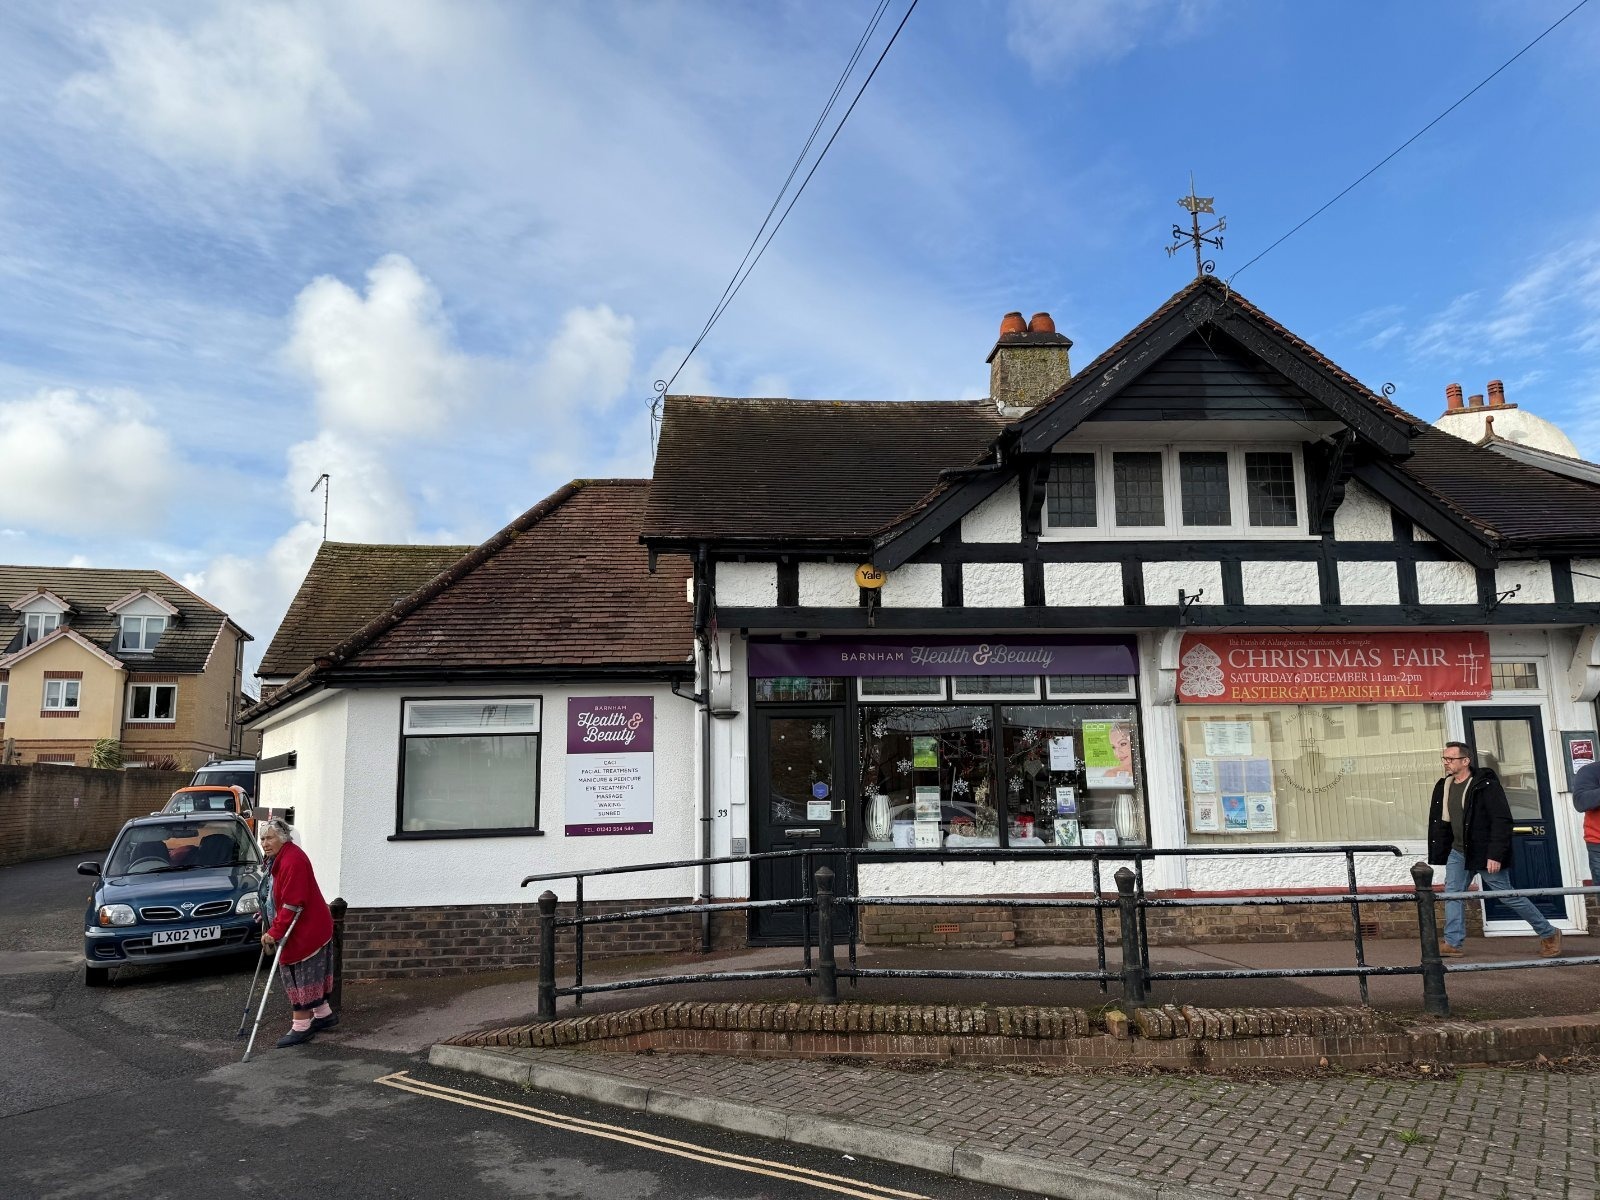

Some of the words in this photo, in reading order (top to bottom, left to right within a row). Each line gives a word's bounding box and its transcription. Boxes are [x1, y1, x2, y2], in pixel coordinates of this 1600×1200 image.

[861, 570, 882, 580] Yale
[841, 652, 904, 661] BARNHAM
[910, 645, 971, 667] Health
[972, 643, 992, 665] &
[990, 644, 1055, 669] Beauty
[1228, 648, 1382, 669] CHRISTMAS
[1391, 647, 1451, 667] FAIR
[1230, 672, 1294, 683] SATURDAY
[1294, 672, 1301, 683] 6
[1303, 671, 1368, 683] DECEMBER
[1370, 671, 1422, 685] 11am-2pm
[1231, 685, 1327, 699] EASTERGATE
[1329, 685, 1380, 698] PARISH
[1383, 684, 1424, 698] HALL
[577, 711, 627, 729] Health
[627, 712, 643, 730] &
[583, 726, 636, 746] Beauty
[717, 808, 728, 818] 33
[1532, 825, 1546, 836] 35
[157, 930, 190, 944] LX02
[193, 926, 216, 939] YGV
